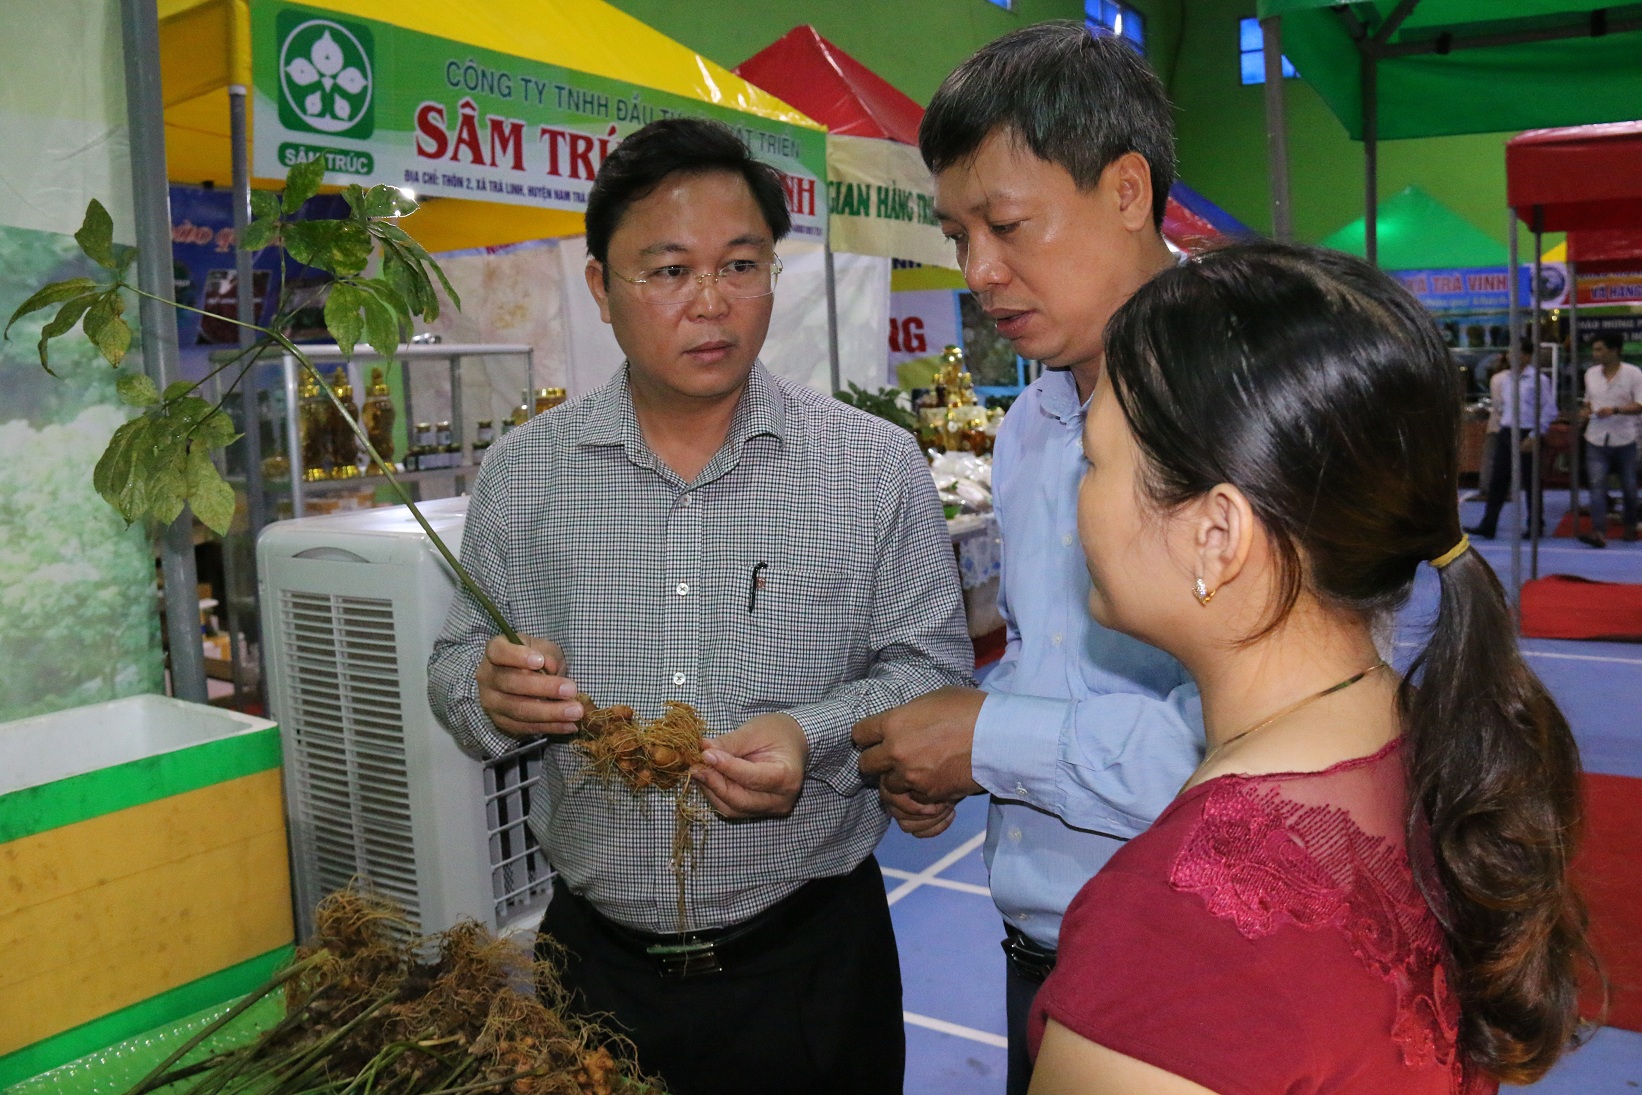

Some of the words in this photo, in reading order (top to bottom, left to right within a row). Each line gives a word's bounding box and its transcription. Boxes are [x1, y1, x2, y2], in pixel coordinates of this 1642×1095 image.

[446, 59, 512, 99] CÔNG
[520, 77, 546, 104] TY
[555, 85, 609, 118] TNHH
[616, 91, 654, 126] ĐẦU
[326, 152, 368, 174] TRÚC
[415, 99, 526, 172] SÂM
